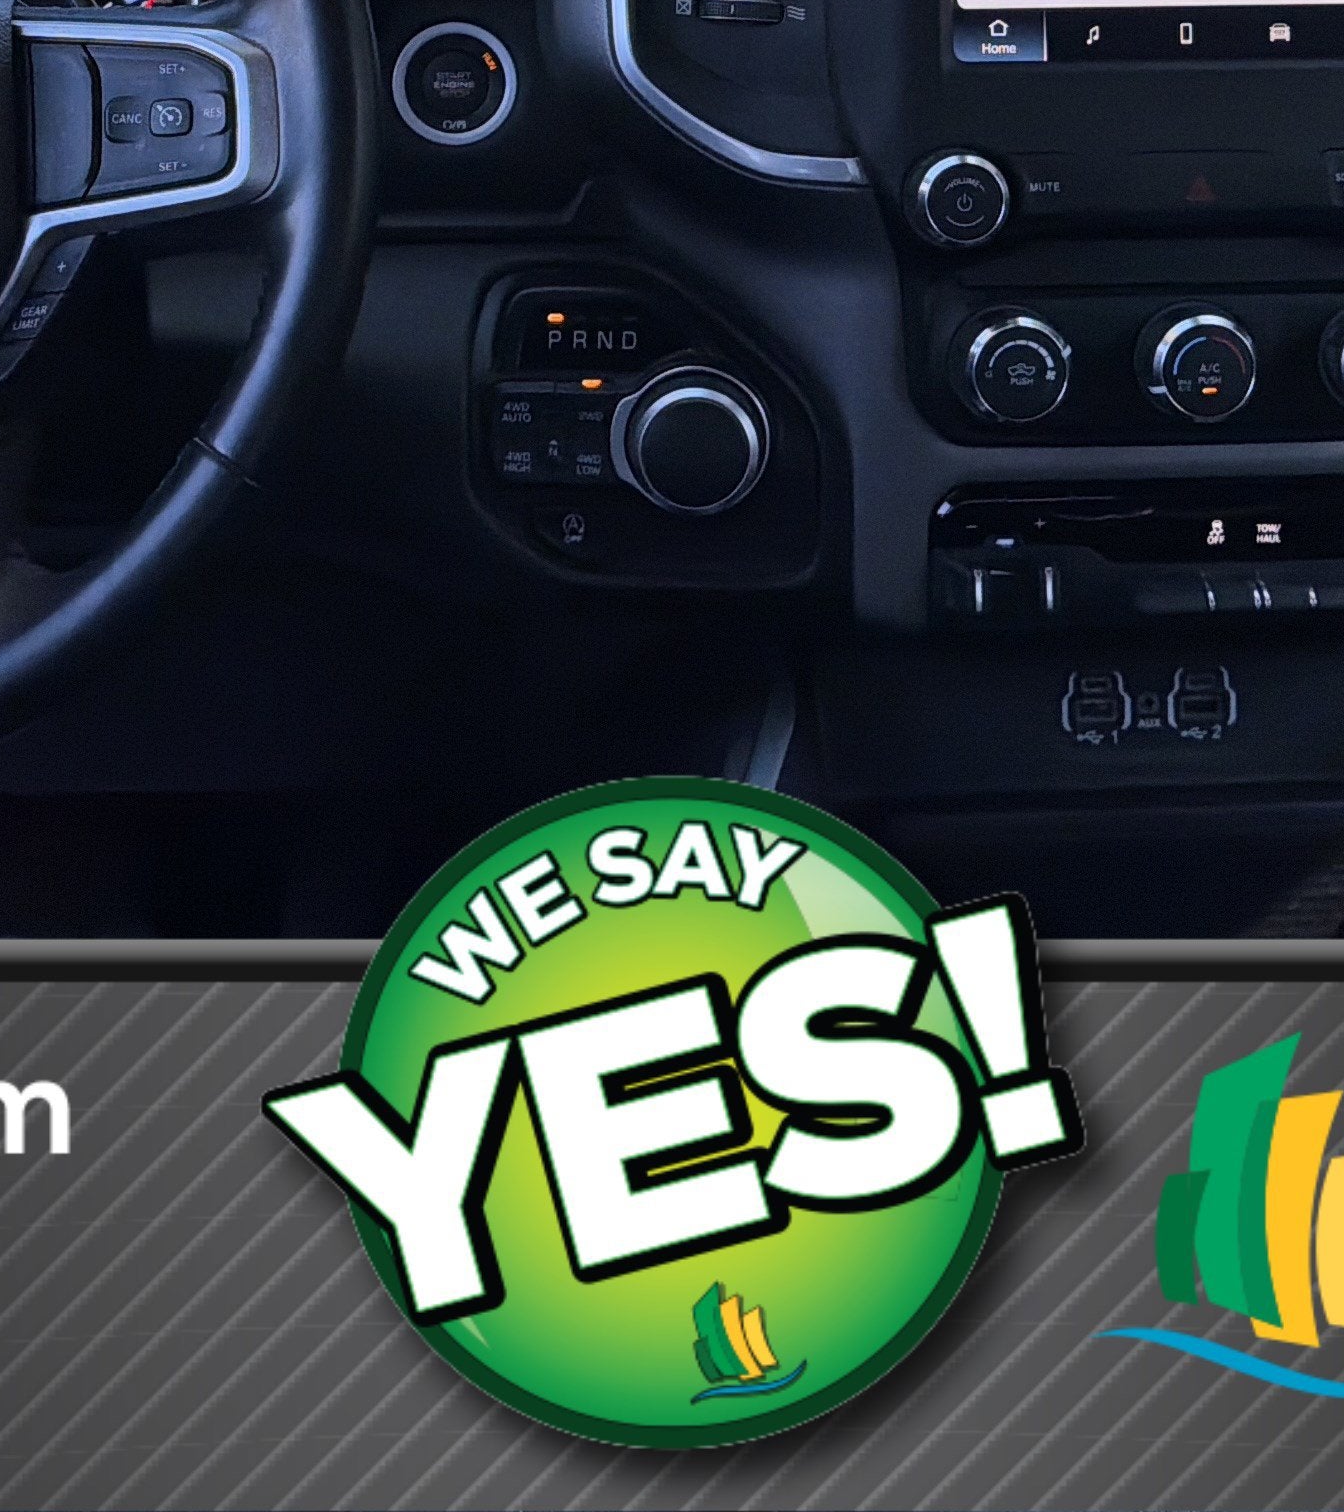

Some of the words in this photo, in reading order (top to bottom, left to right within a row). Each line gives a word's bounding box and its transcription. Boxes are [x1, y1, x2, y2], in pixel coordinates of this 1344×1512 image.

[981, 43, 1017, 54] Home
[202, 106, 223, 119] RES
[111, 113, 143, 125] CANC
[1029, 181, 1061, 192] MUTE
[20, 304, 49, 319] GEAR
[12, 318, 40, 331] LIMIT
[548, 331, 562, 349] P
[573, 331, 587, 349] R
[597, 331, 613, 349] N
[621, 331, 637, 349] D
[1199, 362, 1220, 374] A/C
[1009, 376, 1034, 386] PUSH
[1197, 376, 1222, 385] PUSH
[501, 412, 532, 423] AUTO
[505, 451, 531, 462] 4WD
[576, 464, 602, 476] LOW
[1207, 535, 1225, 545] OFF
[1256, 534, 1282, 544] HAUL
[1137, 718, 1162, 728] AUX
[1111, 730, 1119, 744] 1
[1211, 724, 1222, 739] 2
